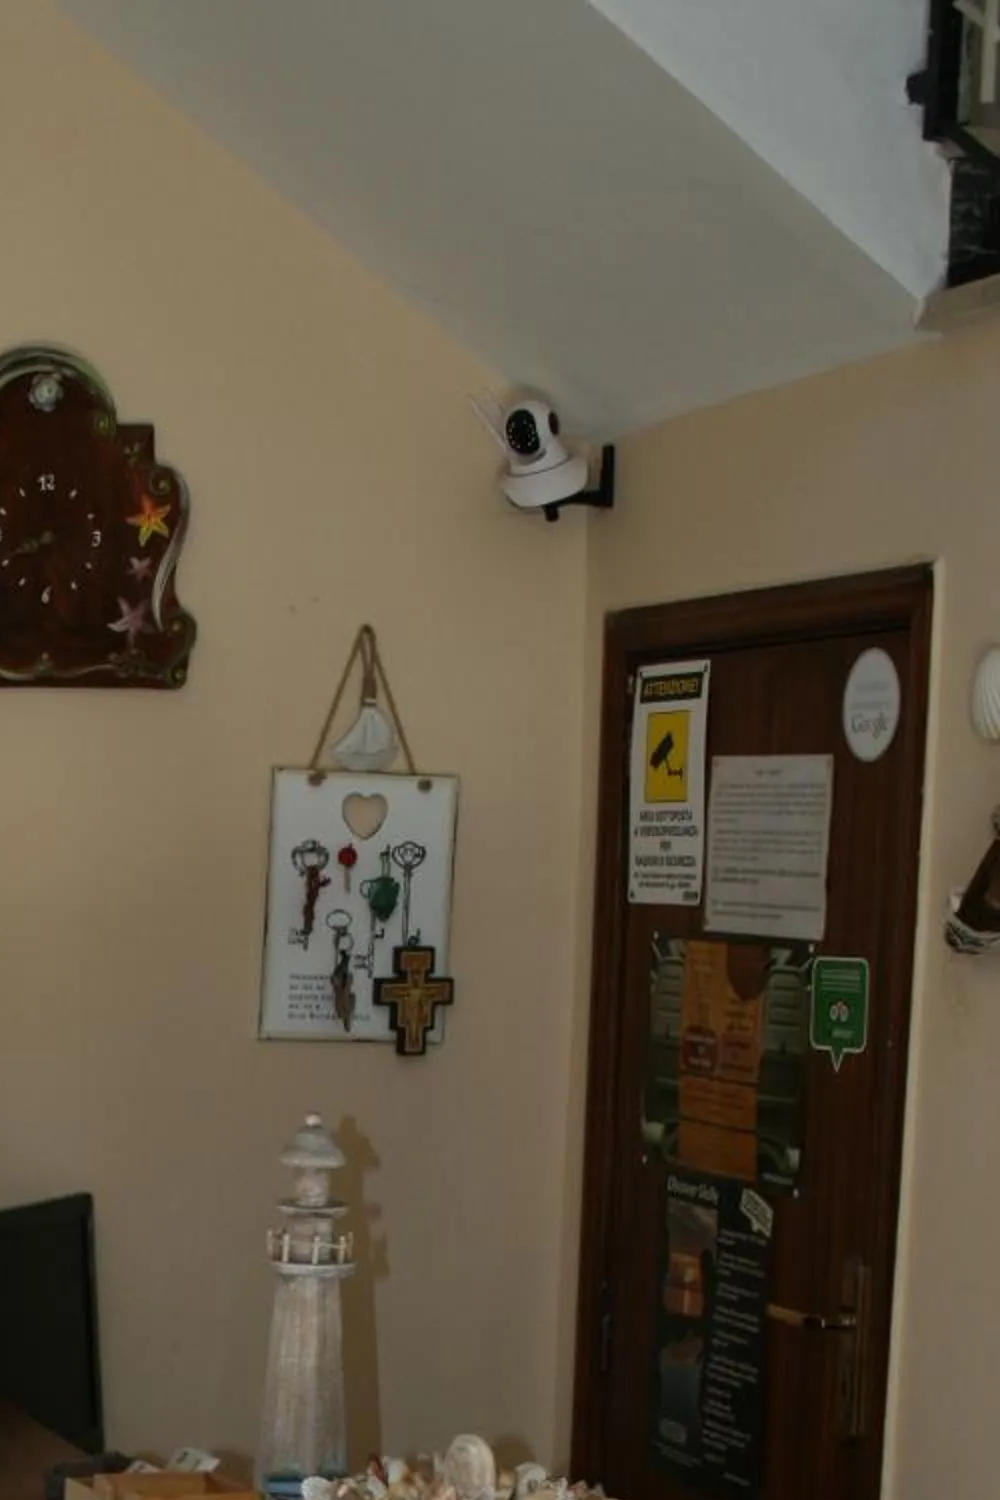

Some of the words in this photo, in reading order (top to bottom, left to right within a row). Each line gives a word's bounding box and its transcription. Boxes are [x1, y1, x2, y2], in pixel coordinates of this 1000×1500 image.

[37, 474, 56, 491] 12
[91, 531, 101, 548] 3
[41, 586, 52, 604] 6
